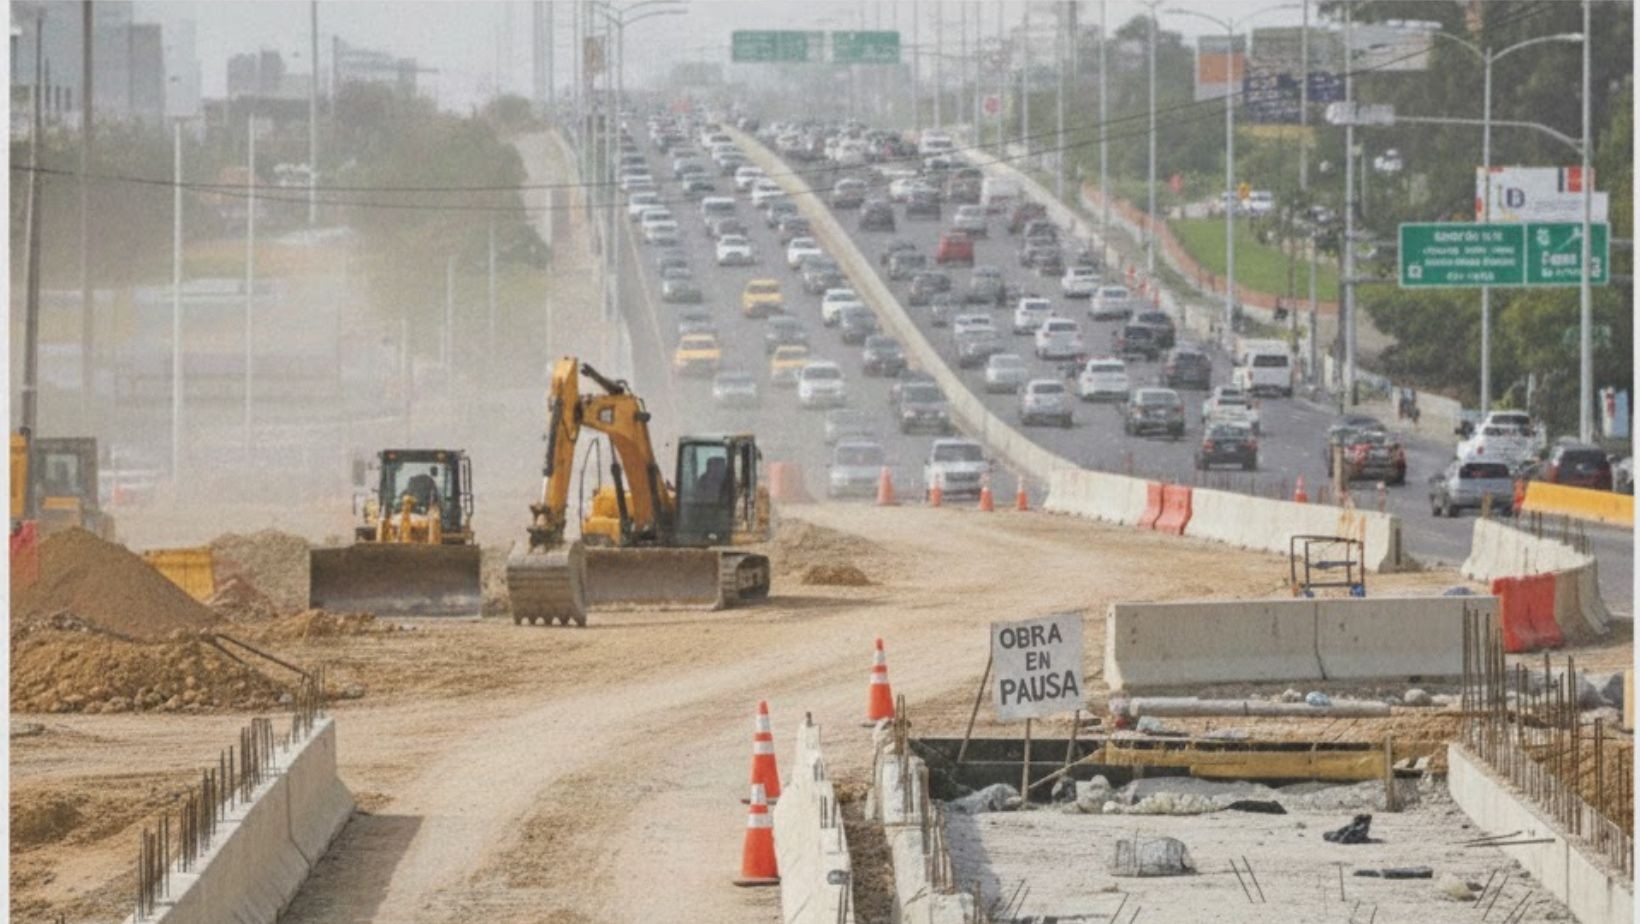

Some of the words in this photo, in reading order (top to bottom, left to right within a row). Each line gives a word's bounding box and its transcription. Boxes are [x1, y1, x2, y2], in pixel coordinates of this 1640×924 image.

[999, 623, 1063, 649] OBRA
[1026, 651, 1051, 671] EN
[1000, 670, 1079, 705] PAUSA
